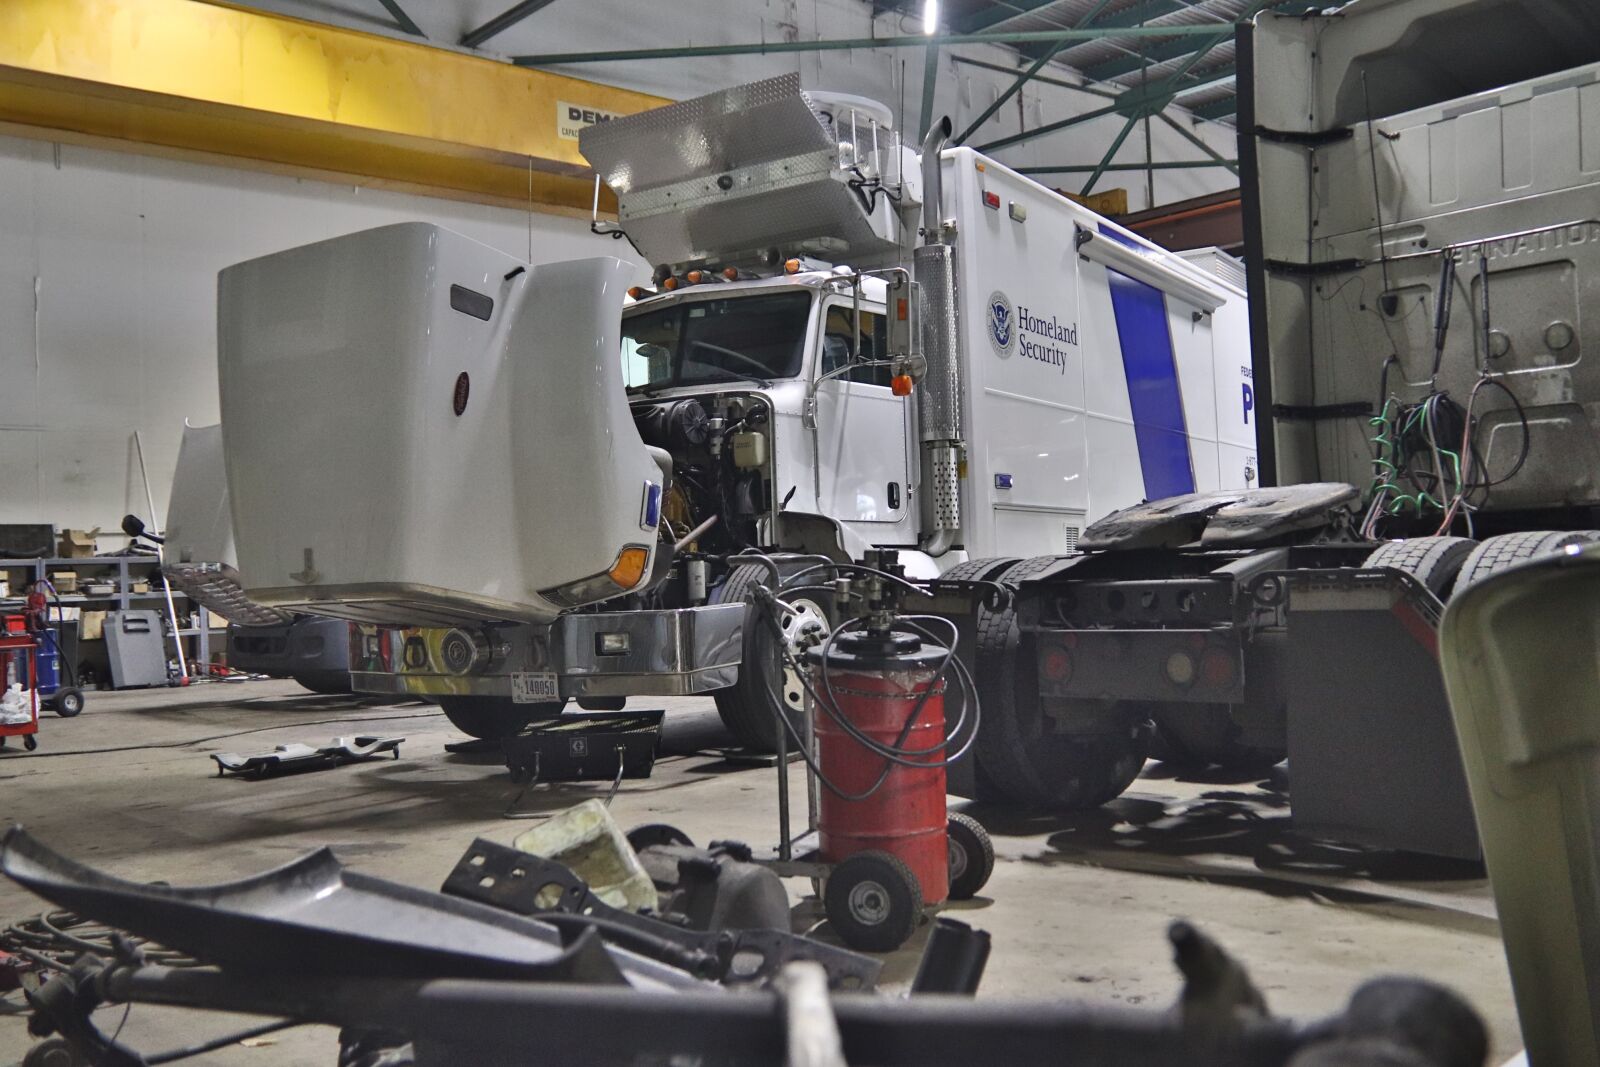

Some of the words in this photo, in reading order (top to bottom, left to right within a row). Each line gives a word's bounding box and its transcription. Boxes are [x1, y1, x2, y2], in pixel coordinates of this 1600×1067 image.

[569, 107, 617, 125] DEM
[1018, 306, 1078, 346] Homeland
[1019, 333, 1067, 375] Security
